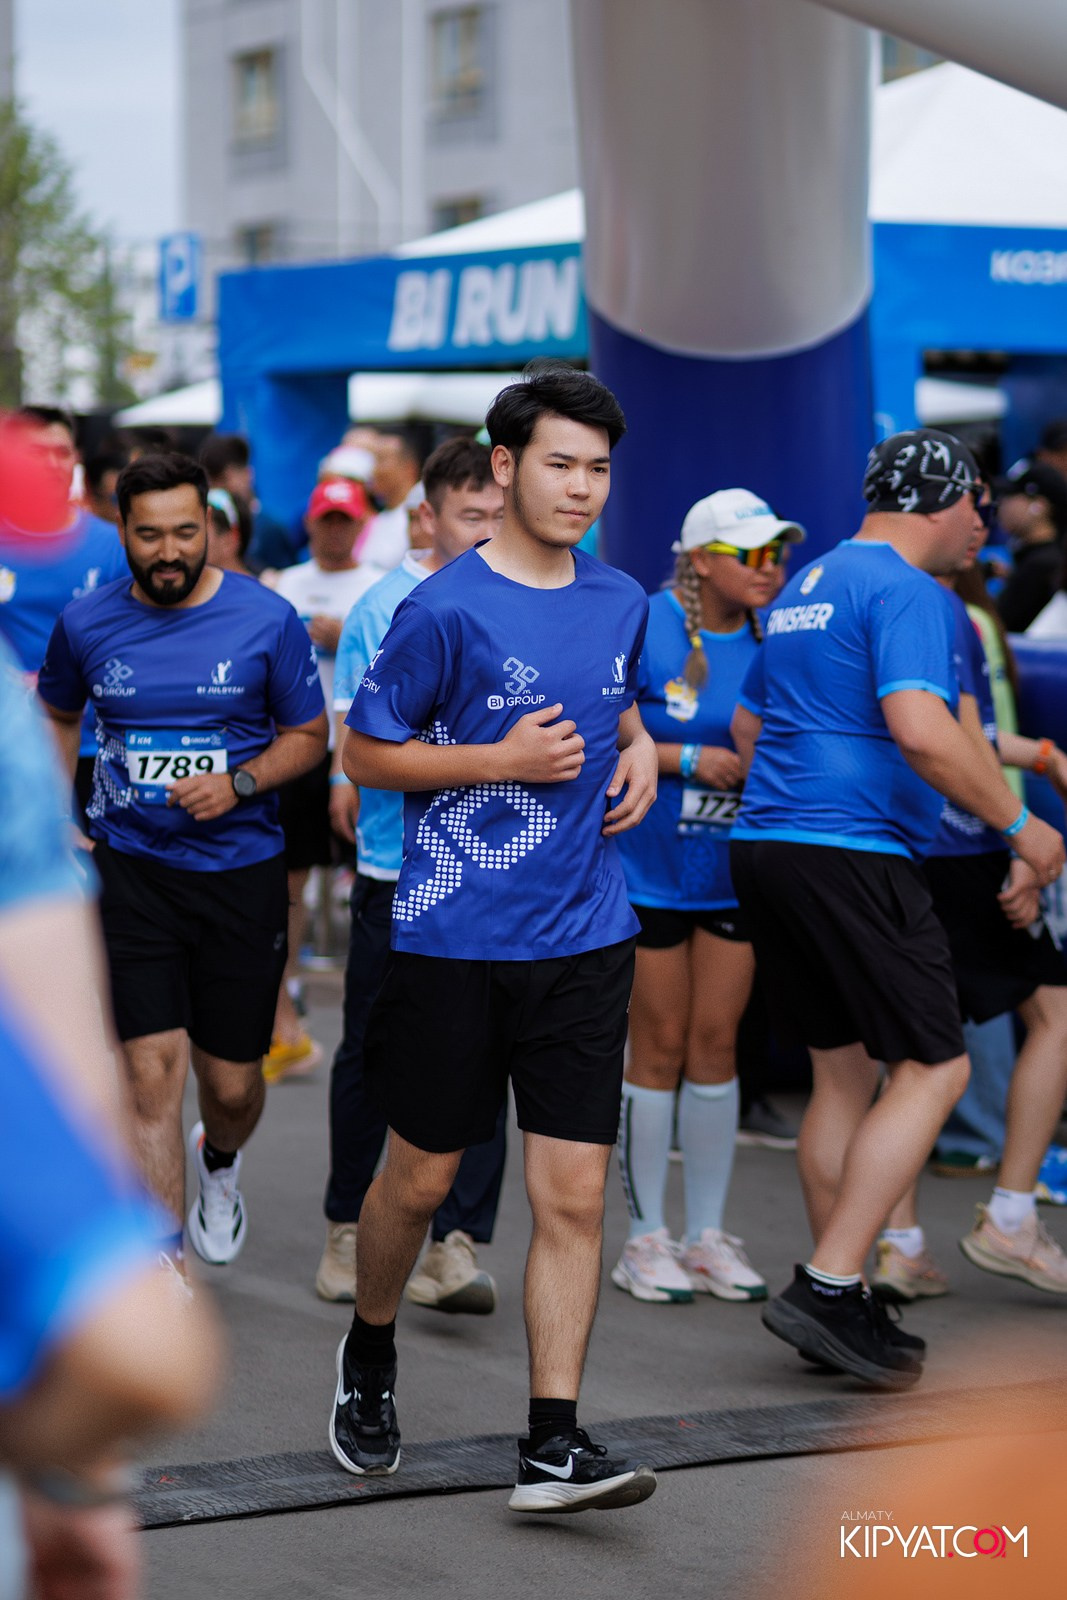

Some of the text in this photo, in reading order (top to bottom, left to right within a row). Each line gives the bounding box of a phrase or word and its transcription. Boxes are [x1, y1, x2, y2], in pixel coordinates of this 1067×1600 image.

[167, 238, 191, 315] P
[386, 256, 580, 352] BI RUN
[103, 687, 136, 697] GROUP
[602, 687, 609, 695] BI
[489, 694, 546, 708] BI GROUP
[138, 755, 214, 780] 1789
